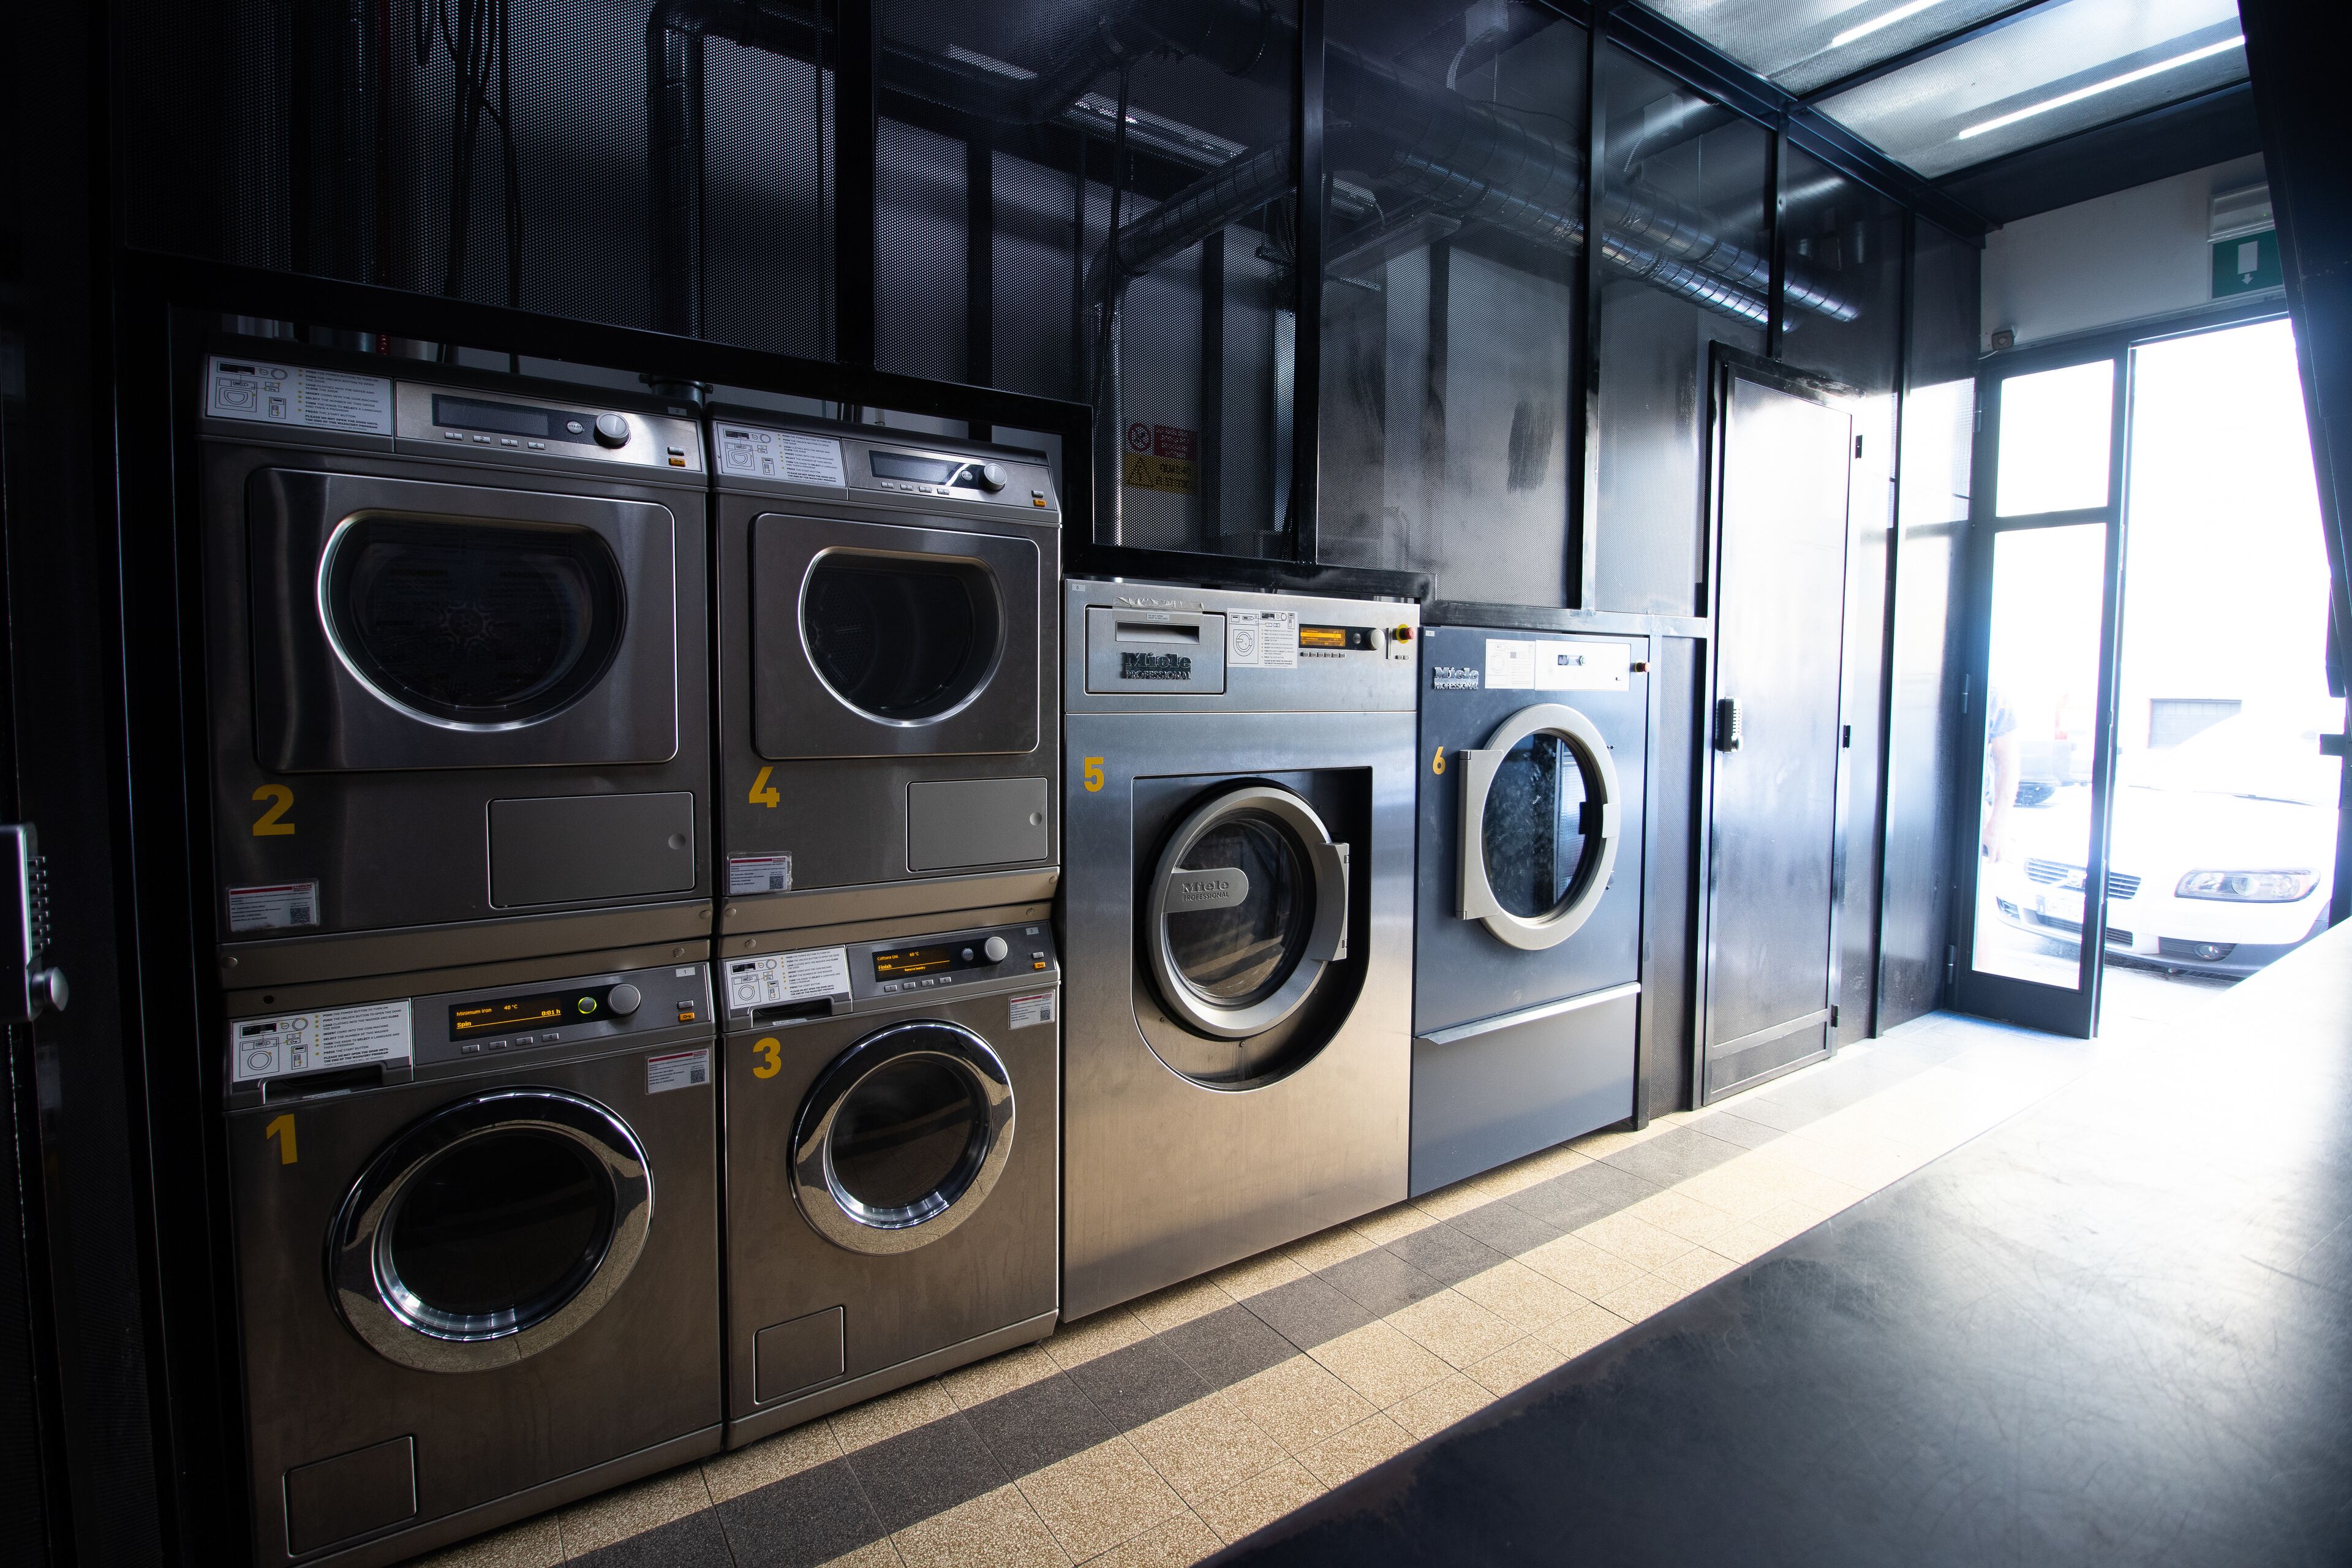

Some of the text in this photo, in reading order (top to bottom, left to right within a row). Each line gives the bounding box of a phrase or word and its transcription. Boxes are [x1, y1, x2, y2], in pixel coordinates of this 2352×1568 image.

[1123, 652, 1192, 668] Miele
[1434, 667, 1479, 679] Miele
[1125, 670, 1191, 680] PROFESSIONAL
[1084, 756, 1104, 792] 5
[1432, 746, 1446, 775] 6
[748, 766, 780, 809] 4
[252, 784, 295, 836] 2
[1182, 880, 1229, 893] Miele
[1182, 891, 1229, 902] PROFESSIONAL
[751, 1037, 782, 1081] 3
[266, 1114, 298, 1165] 1
